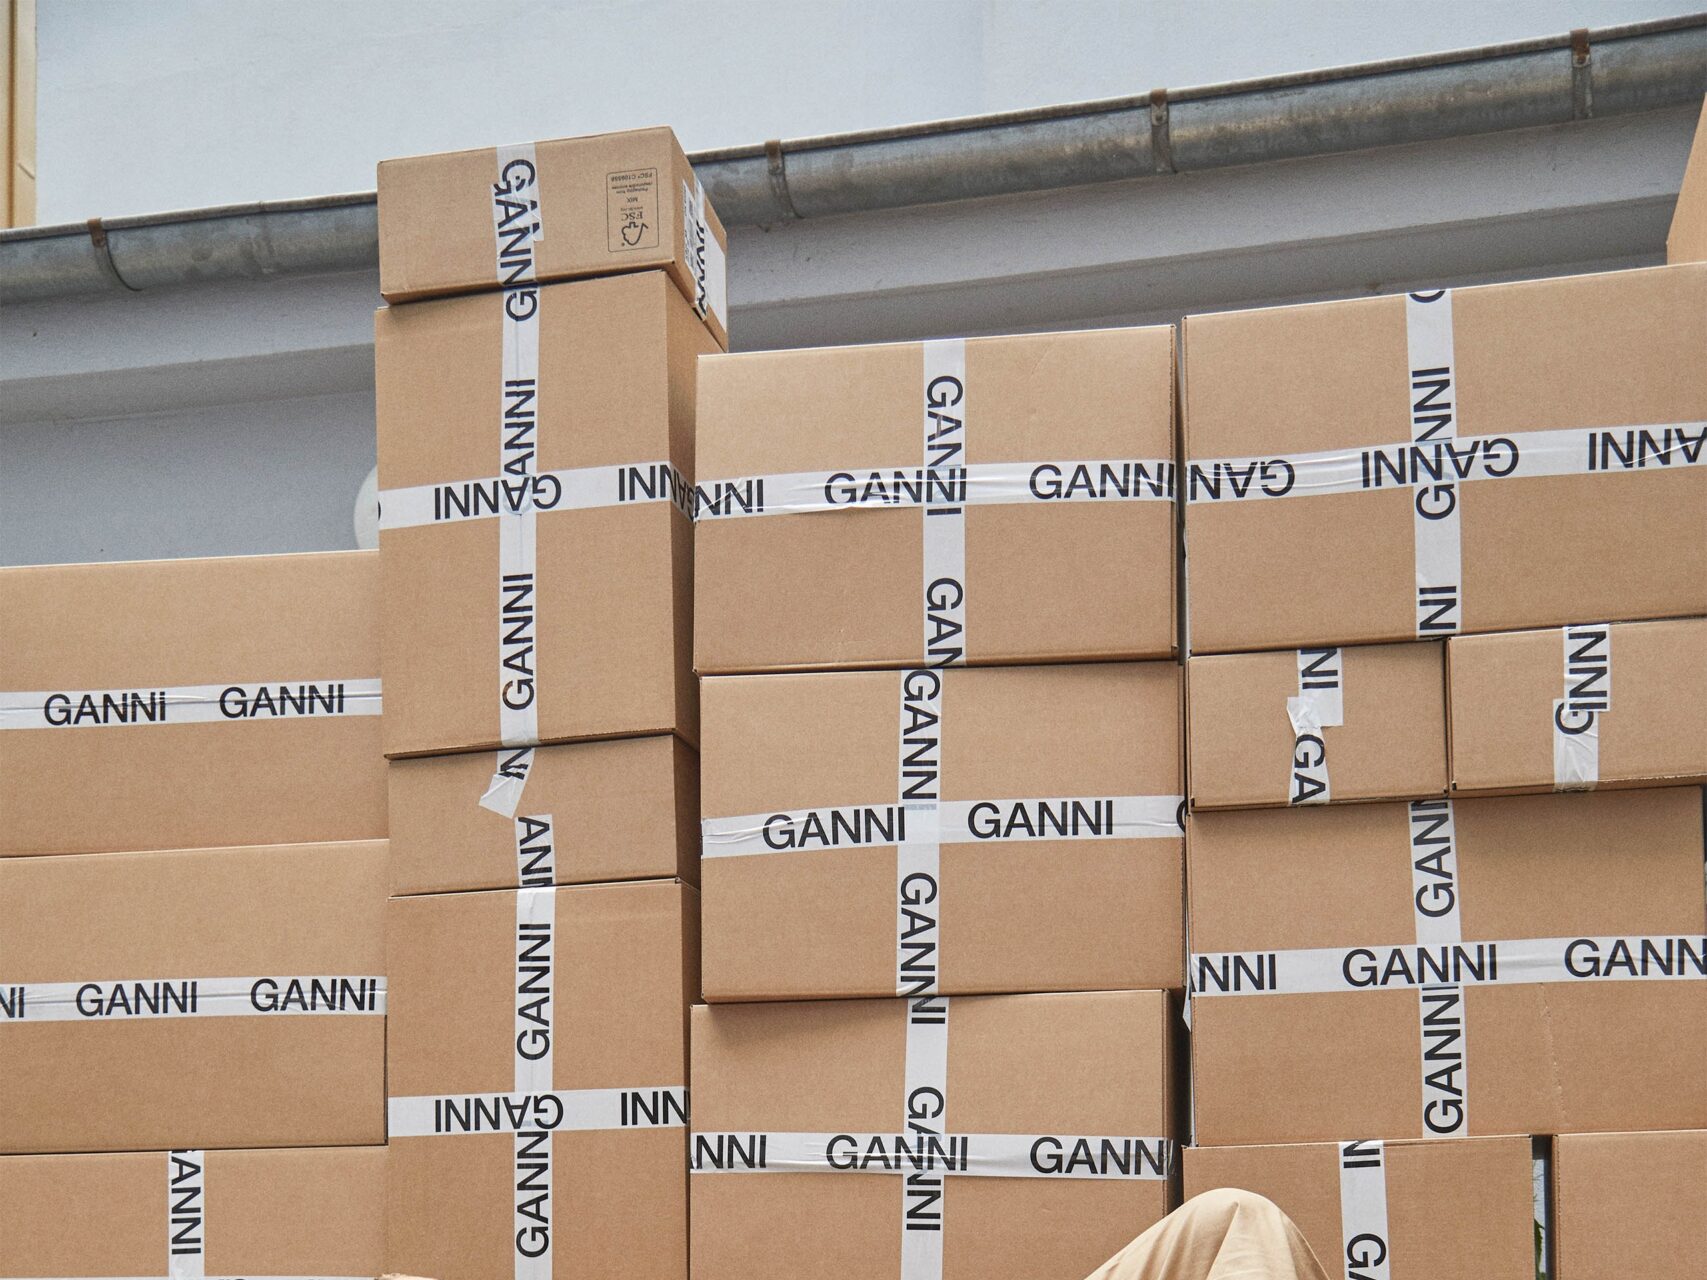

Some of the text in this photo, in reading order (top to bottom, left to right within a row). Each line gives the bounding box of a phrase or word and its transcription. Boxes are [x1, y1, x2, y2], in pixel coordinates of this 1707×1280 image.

[621, 211, 643, 221] FSC
[504, 379, 535, 476] ANNI
[927, 376, 963, 516] GANI
[1412, 367, 1456, 520] GNNI
[825, 468, 967, 504] GANNI
[1029, 463, 1175, 499] GANNI
[1362, 438, 1519, 488] GANNI
[434, 474, 562, 520] GANNI
[502, 573, 535, 710] GANNI
[44, 684, 345, 726] GANNI GANNI
[762, 799, 1113, 850] GANNI GANNI
[517, 923, 551, 1061] GANNI
[1191, 954, 1277, 992] NNI
[1342, 943, 1498, 988] GANNI
[76, 978, 376, 1017] GANNI GANNI
[1422, 984, 1463, 1134] GANNI
[434, 1094, 564, 1132] GANNI
[689, 1134, 767, 1170] NNI
[826, 1134, 968, 1172] GANNI
[171, 1149, 202, 1255] ANNI
[516, 1131, 549, 1258] GANN
